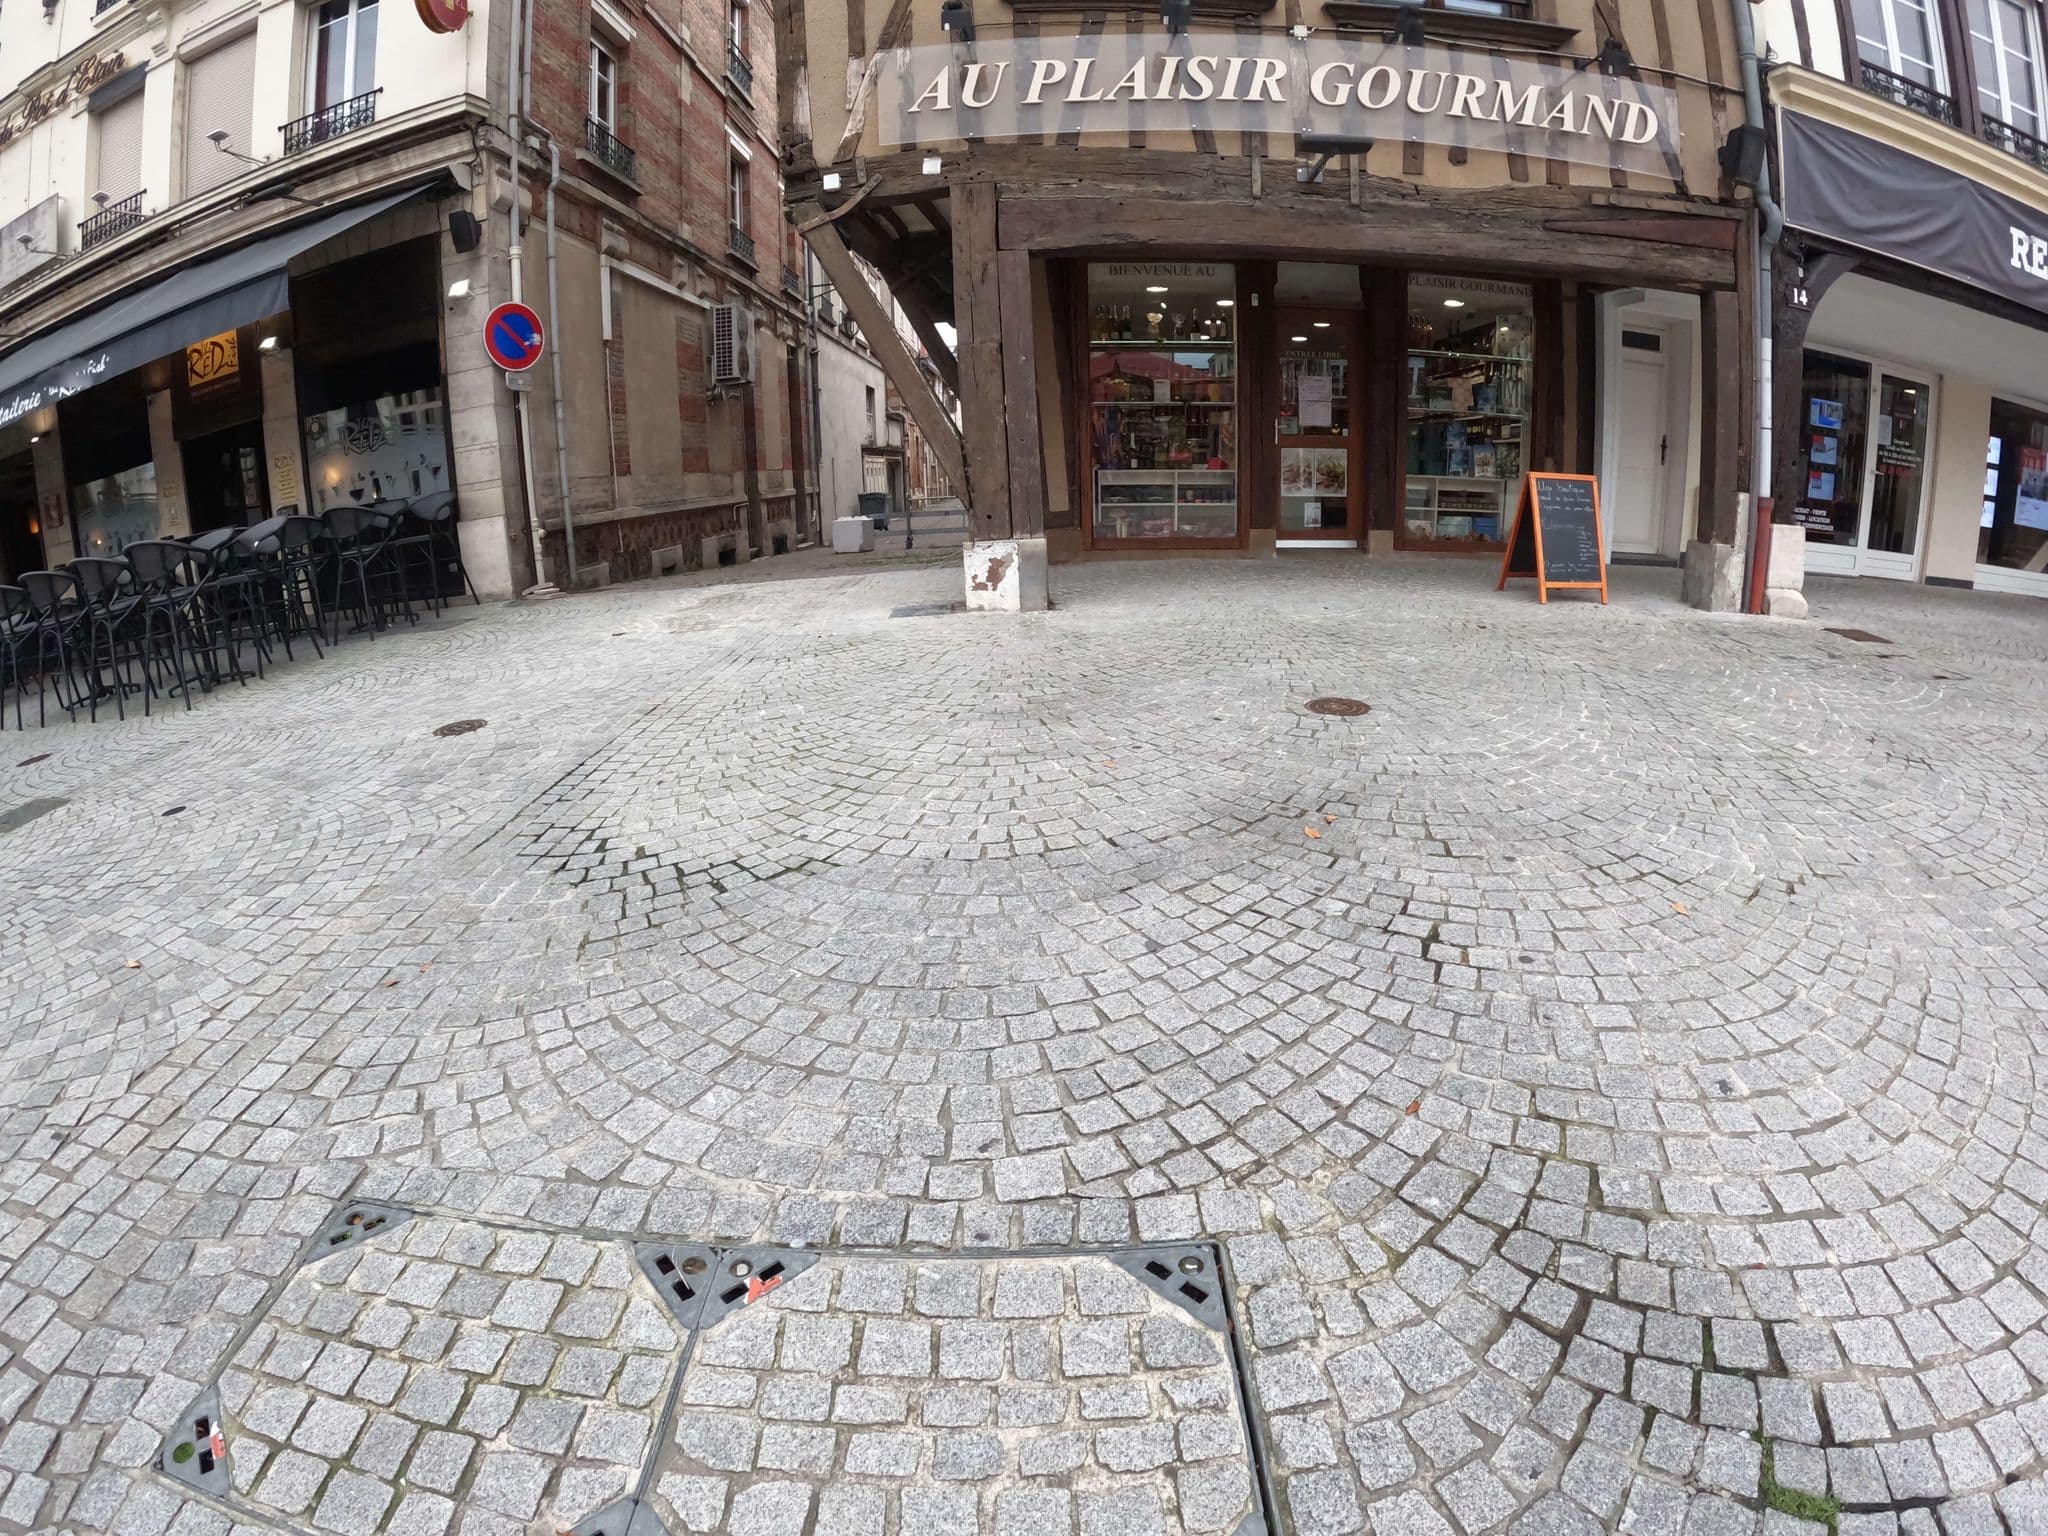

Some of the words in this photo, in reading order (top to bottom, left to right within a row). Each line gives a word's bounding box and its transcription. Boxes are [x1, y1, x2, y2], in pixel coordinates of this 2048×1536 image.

[907, 61, 1010, 112] AU
[1021, 56, 1288, 103] PLAISIR
[1310, 61, 1659, 144] GOURMAND
[1108, 264, 1192, 277] BIENVENUE
[1197, 265, 1216, 277] AU
[1407, 274, 1457, 289] PLAISIR
[1793, 287, 1808, 306] 14
